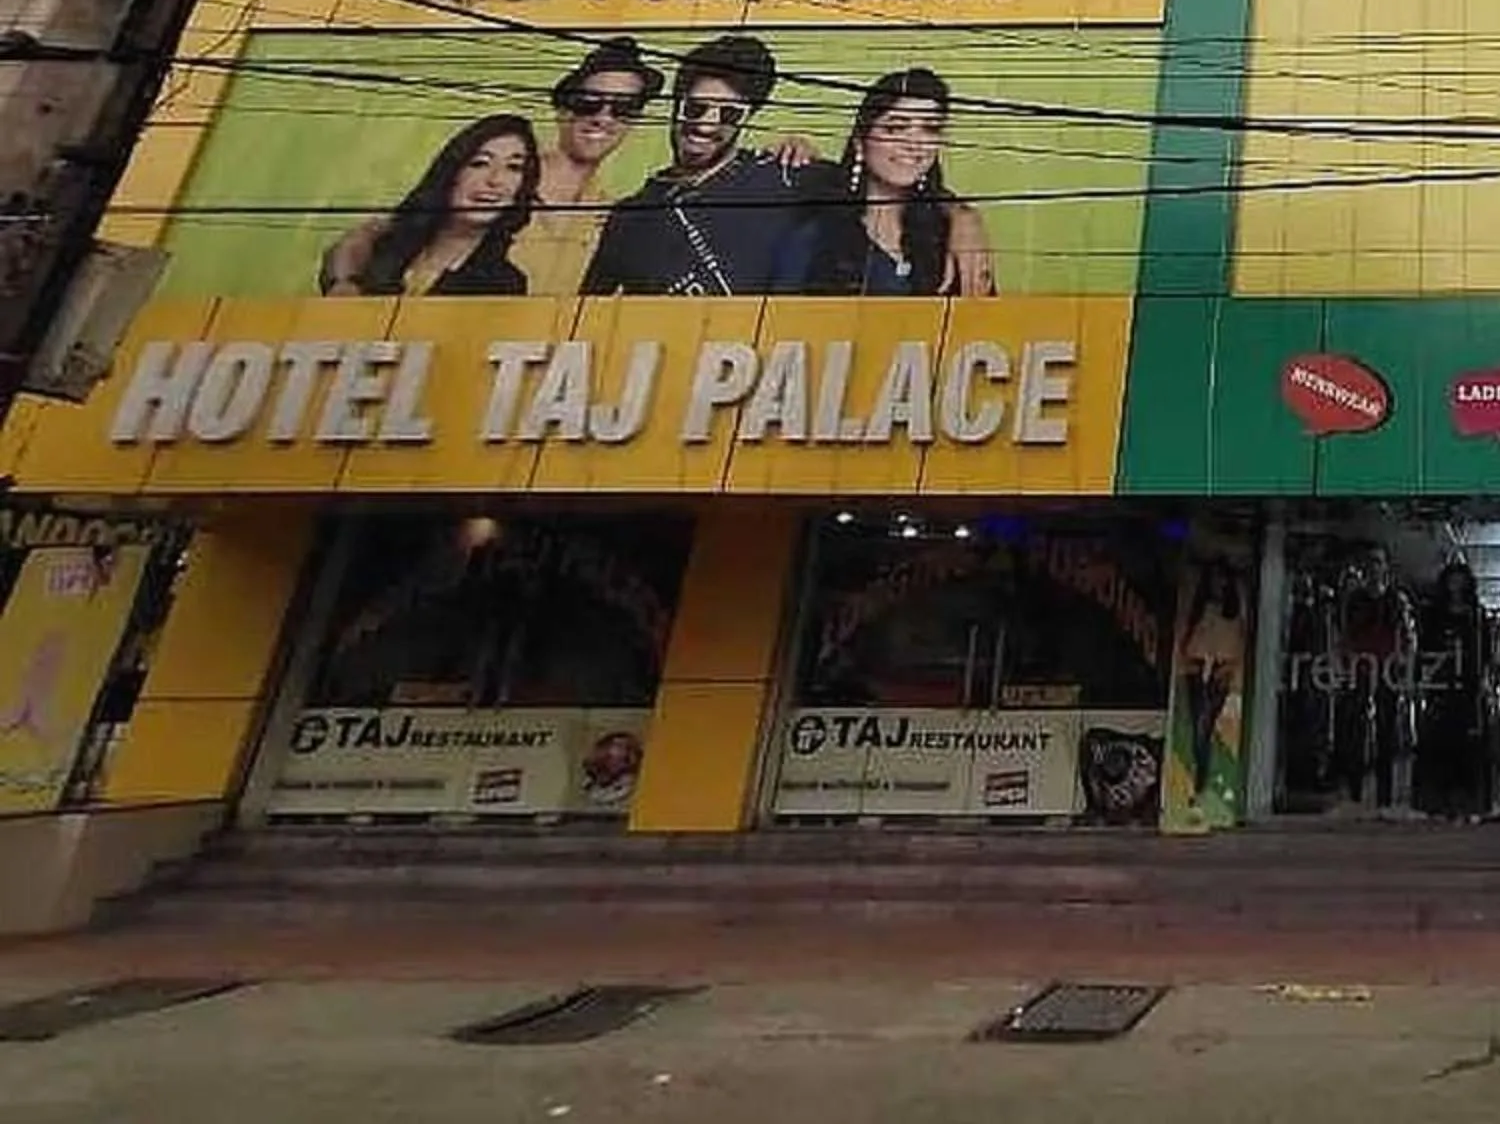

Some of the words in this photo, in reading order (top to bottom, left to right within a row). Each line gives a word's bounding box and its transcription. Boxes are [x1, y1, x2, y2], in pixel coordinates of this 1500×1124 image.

[112, 340, 434, 445] HOTEL
[479, 340, 662, 445] TAJ
[679, 339, 1078, 445] PALACE
[334, 715, 415, 749] TAJ
[411, 730, 554, 748] RESTAURANT
[833, 716, 909, 749] TAJ
[909, 731, 1051, 753] RESTAURANT
